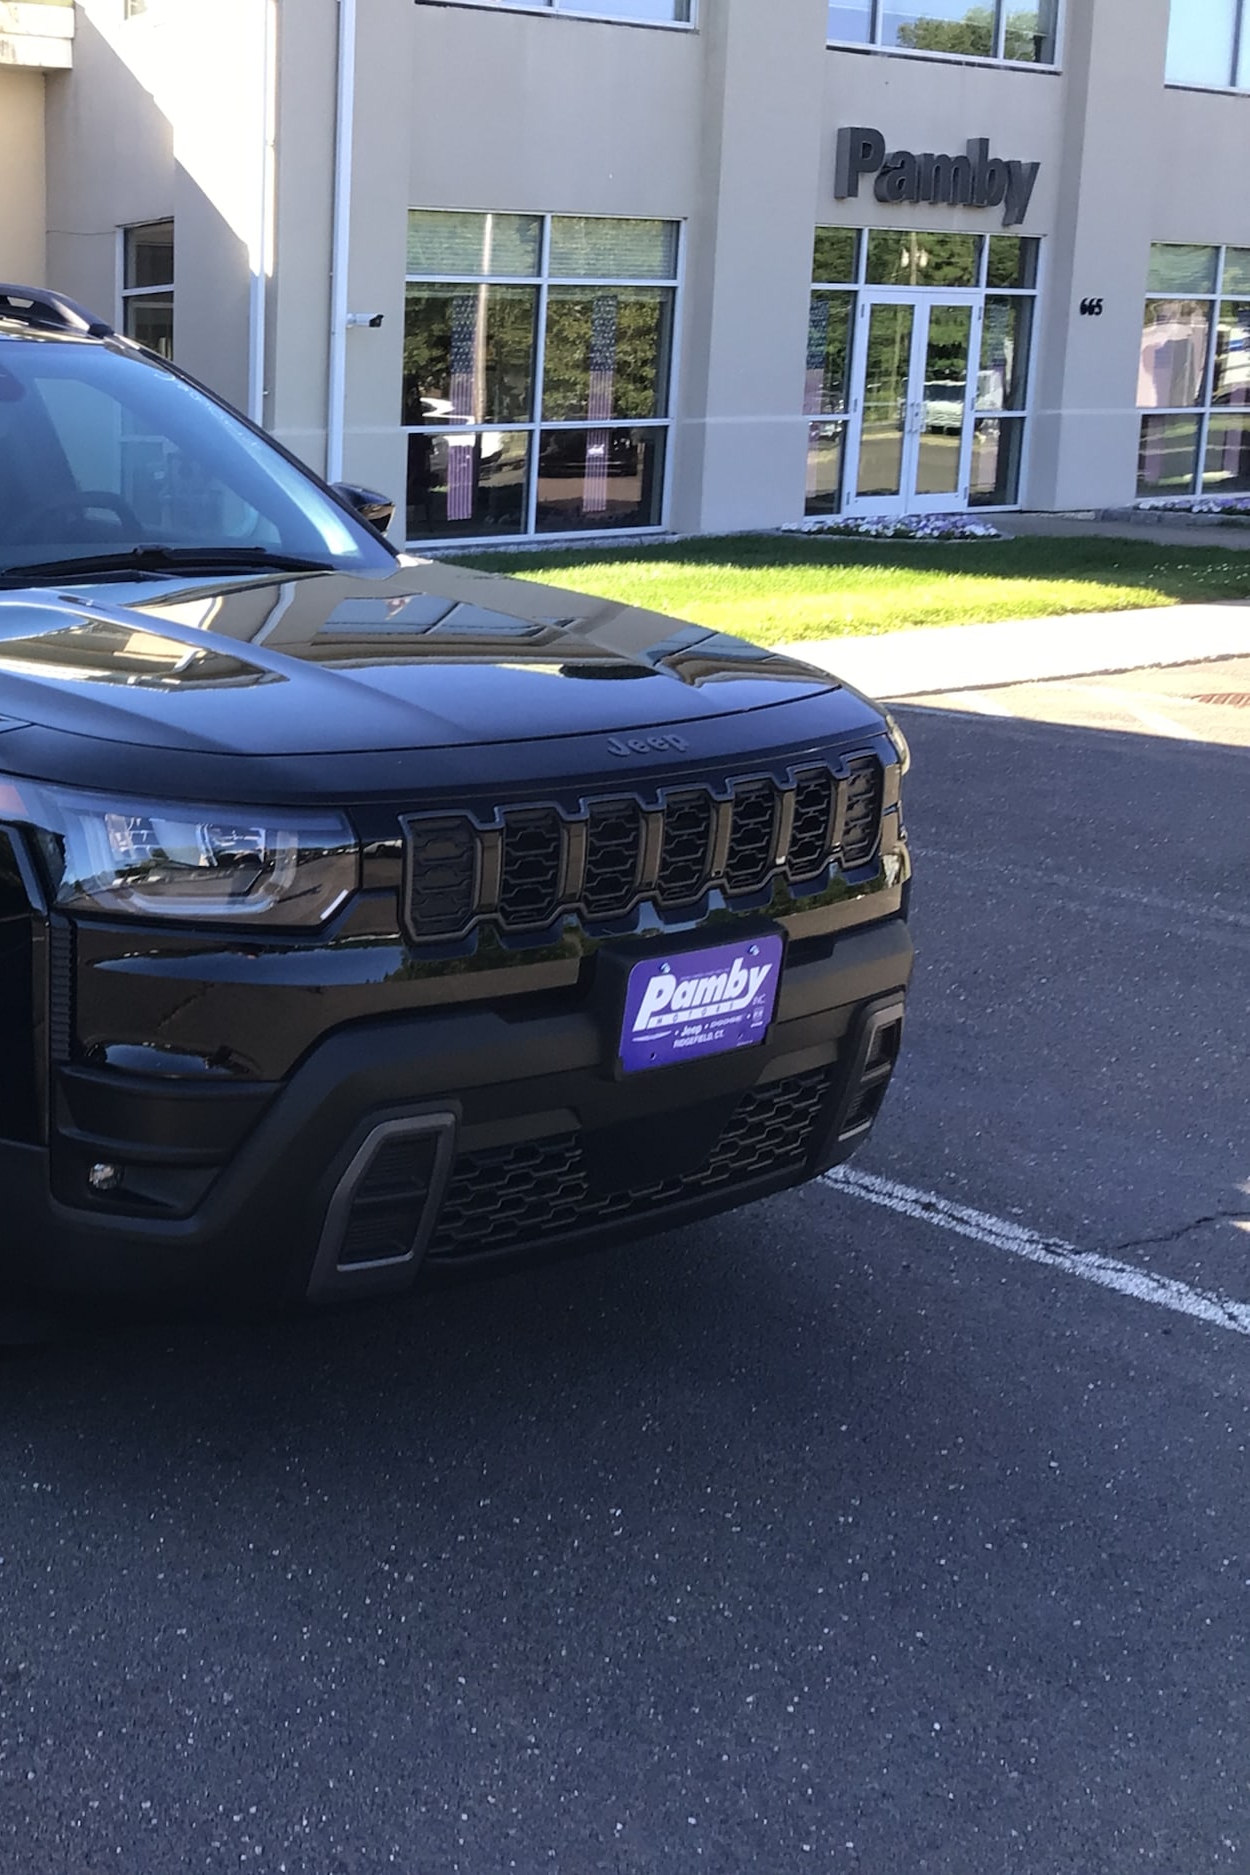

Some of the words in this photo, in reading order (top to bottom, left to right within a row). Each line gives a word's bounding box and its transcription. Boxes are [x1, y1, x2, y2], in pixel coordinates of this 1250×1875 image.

[834, 126, 1041, 226] Pamby
[1080, 297, 1103, 315] 665
[607, 735, 689, 757] Jeep
[632, 957, 773, 1032] Pamby
[680, 1024, 703, 1037] Jeep
